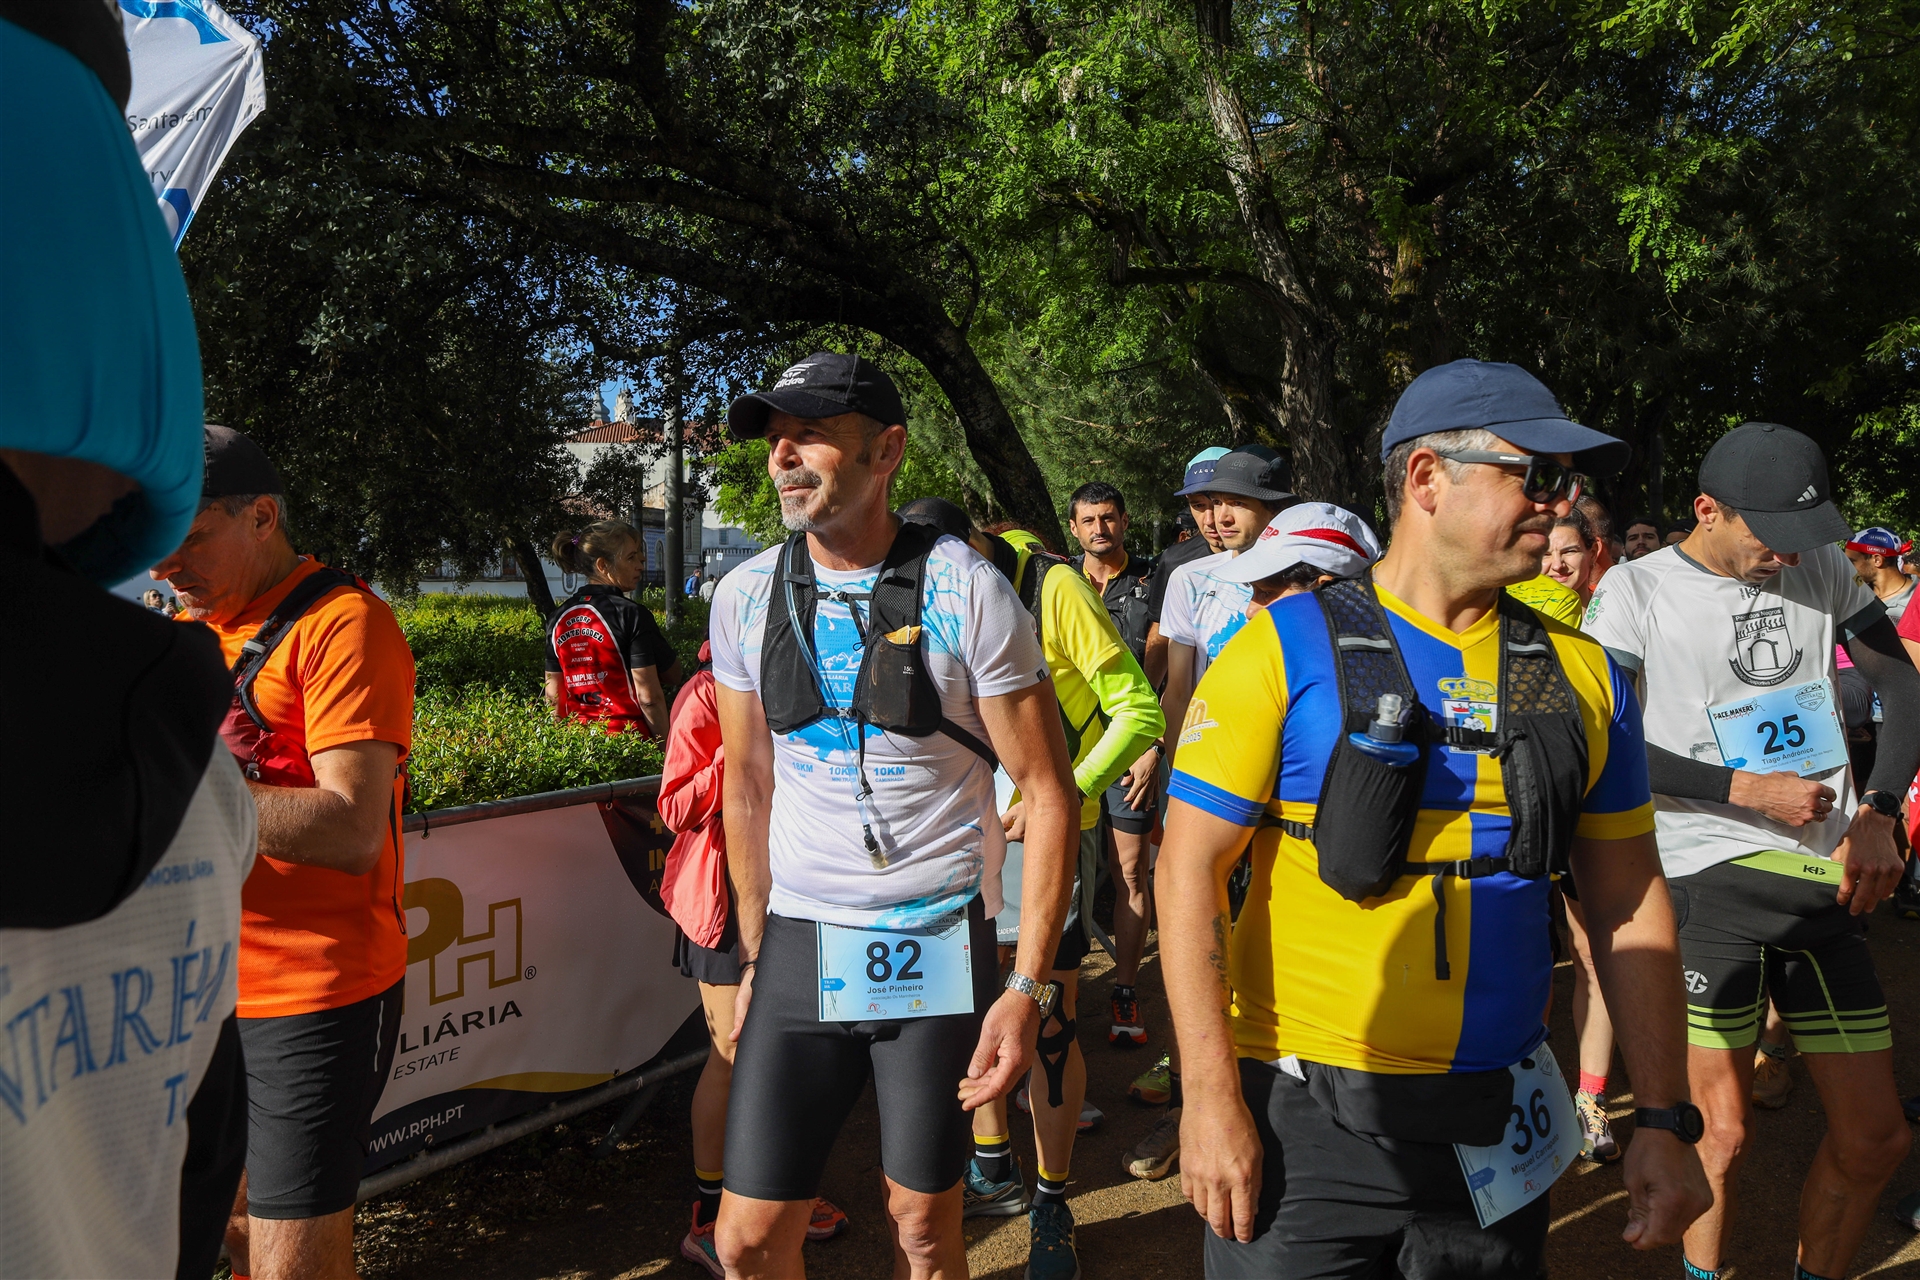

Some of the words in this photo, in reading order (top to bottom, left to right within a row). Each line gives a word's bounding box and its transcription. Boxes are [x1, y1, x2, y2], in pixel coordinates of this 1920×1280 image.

[1757, 713, 1806, 756] 25
[873, 766, 906, 776] 10KM
[1762, 756, 1781, 765] Tiago
[866, 939, 924, 982] 82
[867, 986, 887, 994] José
[889, 984, 924, 993] Pinheiro
[400, 1000, 522, 1055] LIÁRIA
[393, 1047, 460, 1080] ESTATE
[1510, 1088, 1551, 1155] 36
[1511, 1154, 1536, 1176] Miguel
